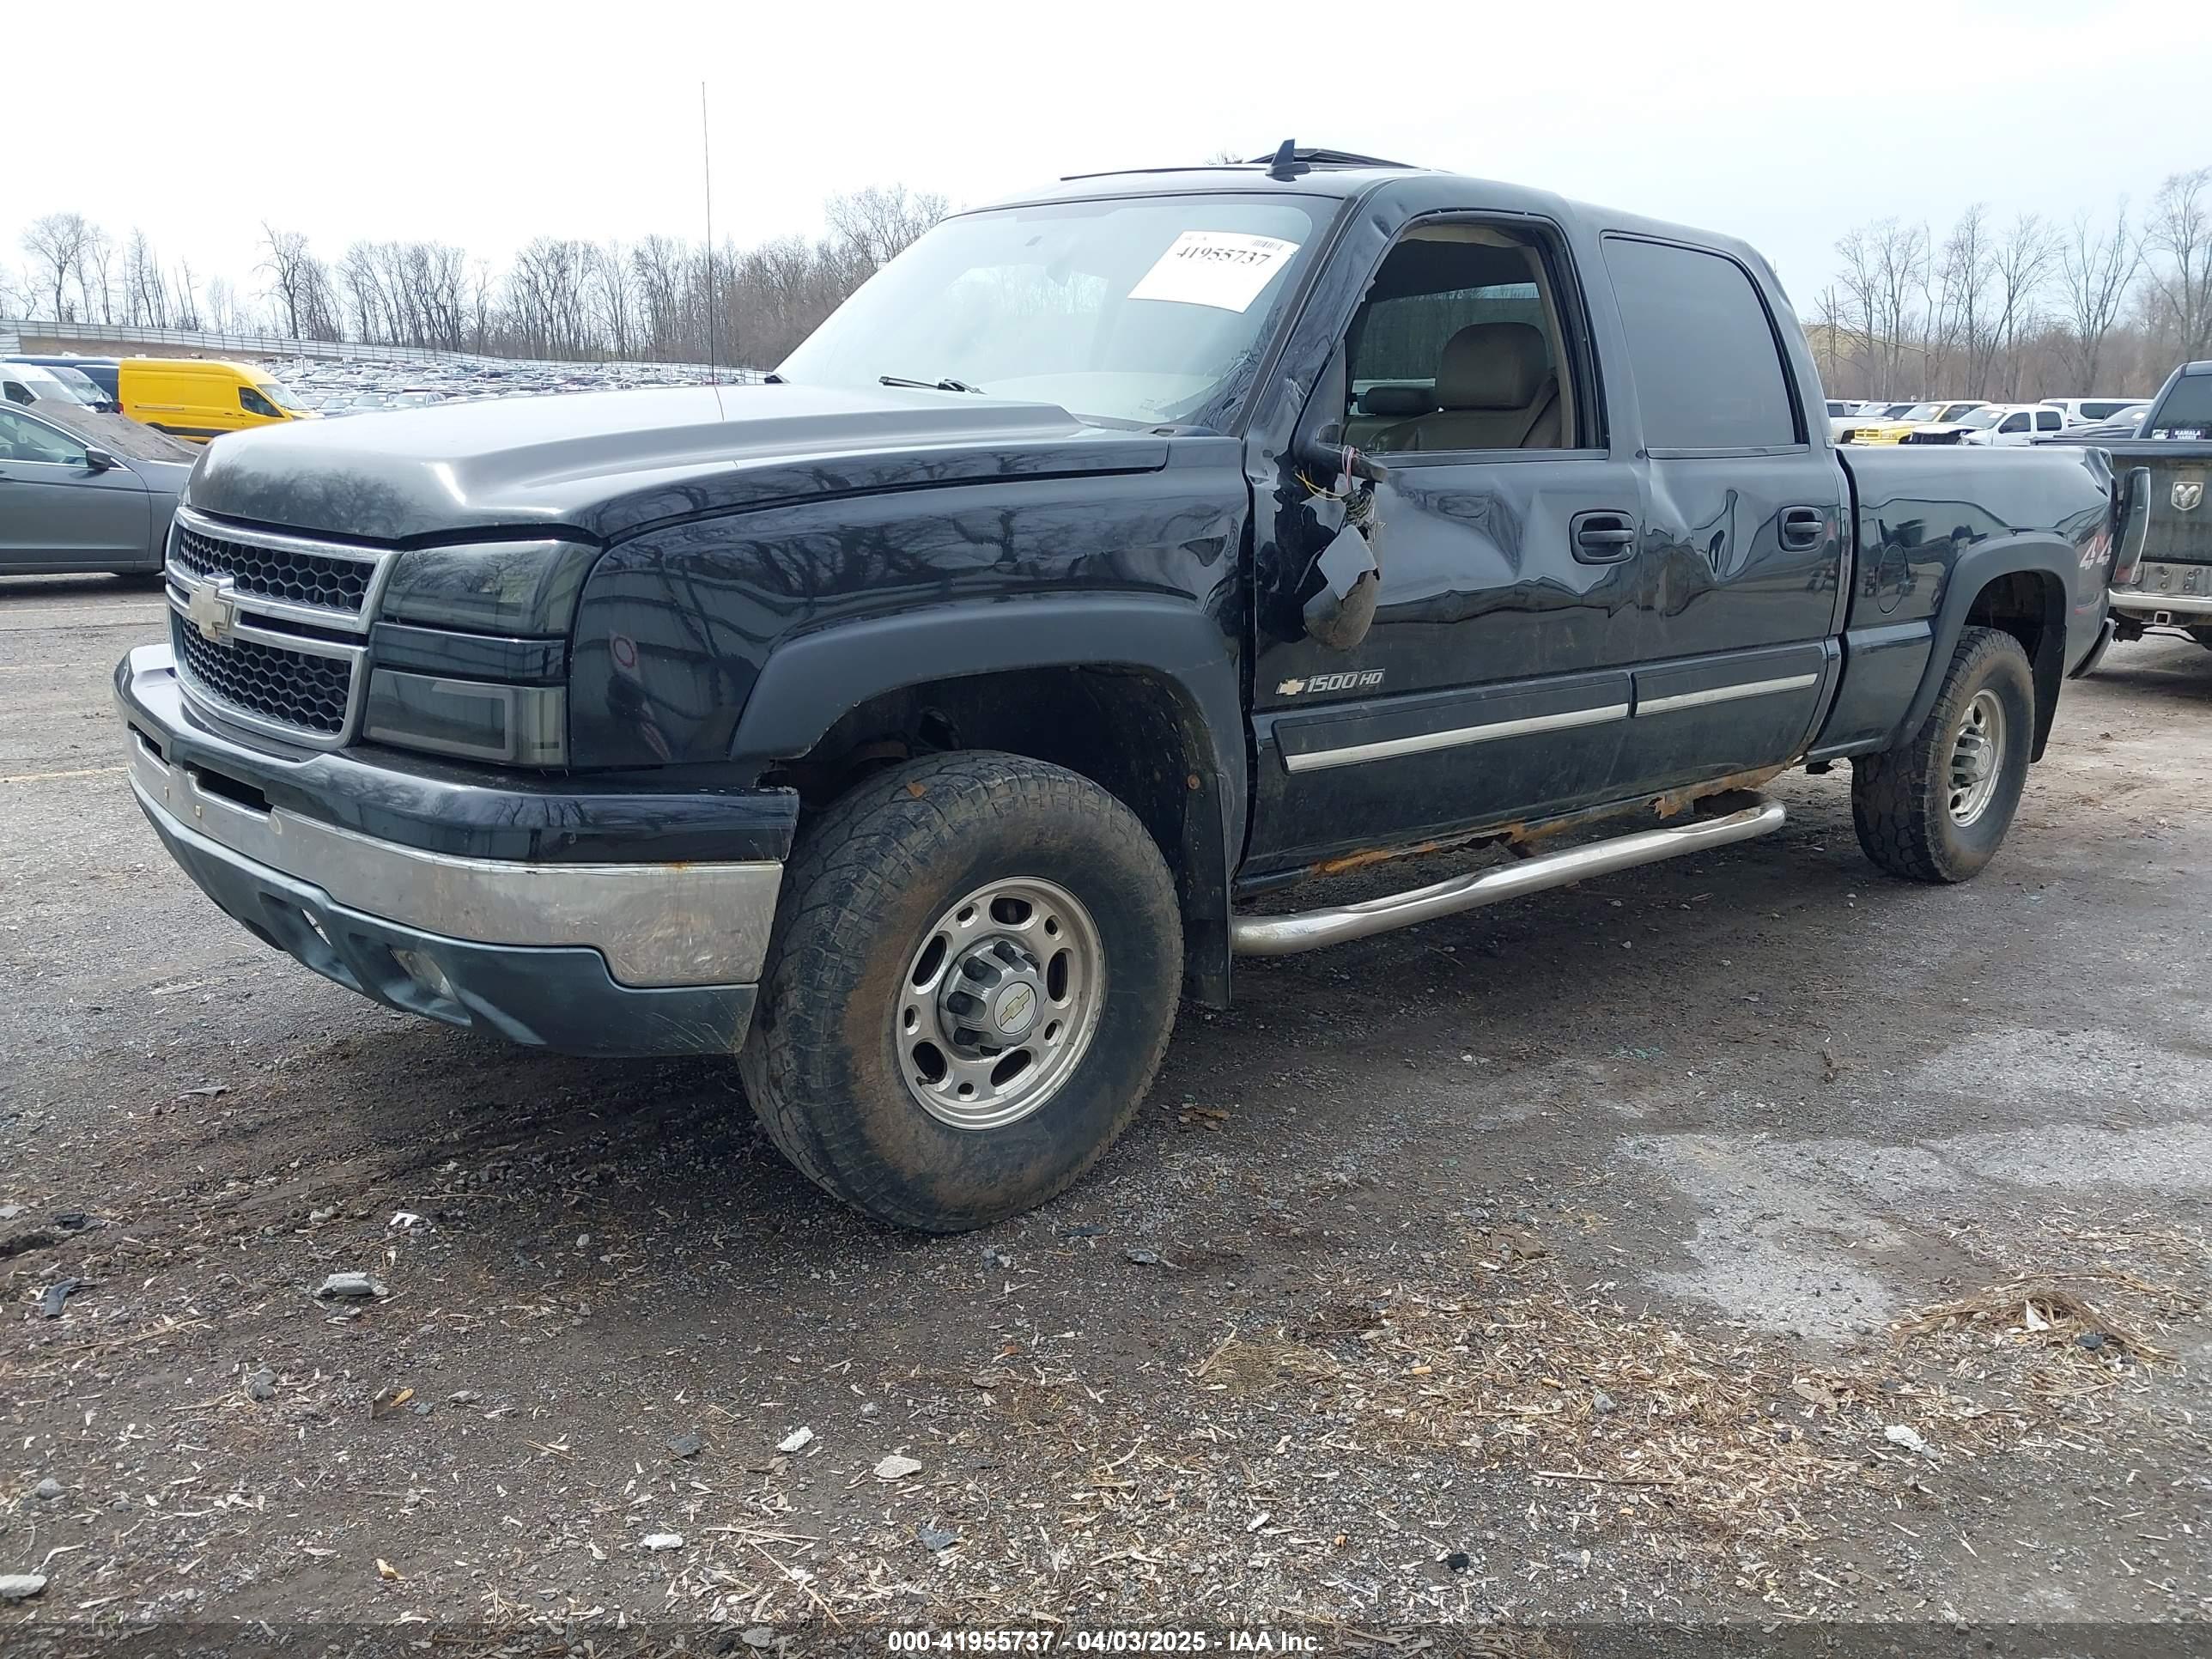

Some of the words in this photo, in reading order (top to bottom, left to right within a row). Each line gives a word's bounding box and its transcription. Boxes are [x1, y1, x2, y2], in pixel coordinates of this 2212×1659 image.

[1176, 246, 1272, 266] 41955737
[1307, 674, 1358, 693] 1500
[1358, 672, 1383, 686] HD
